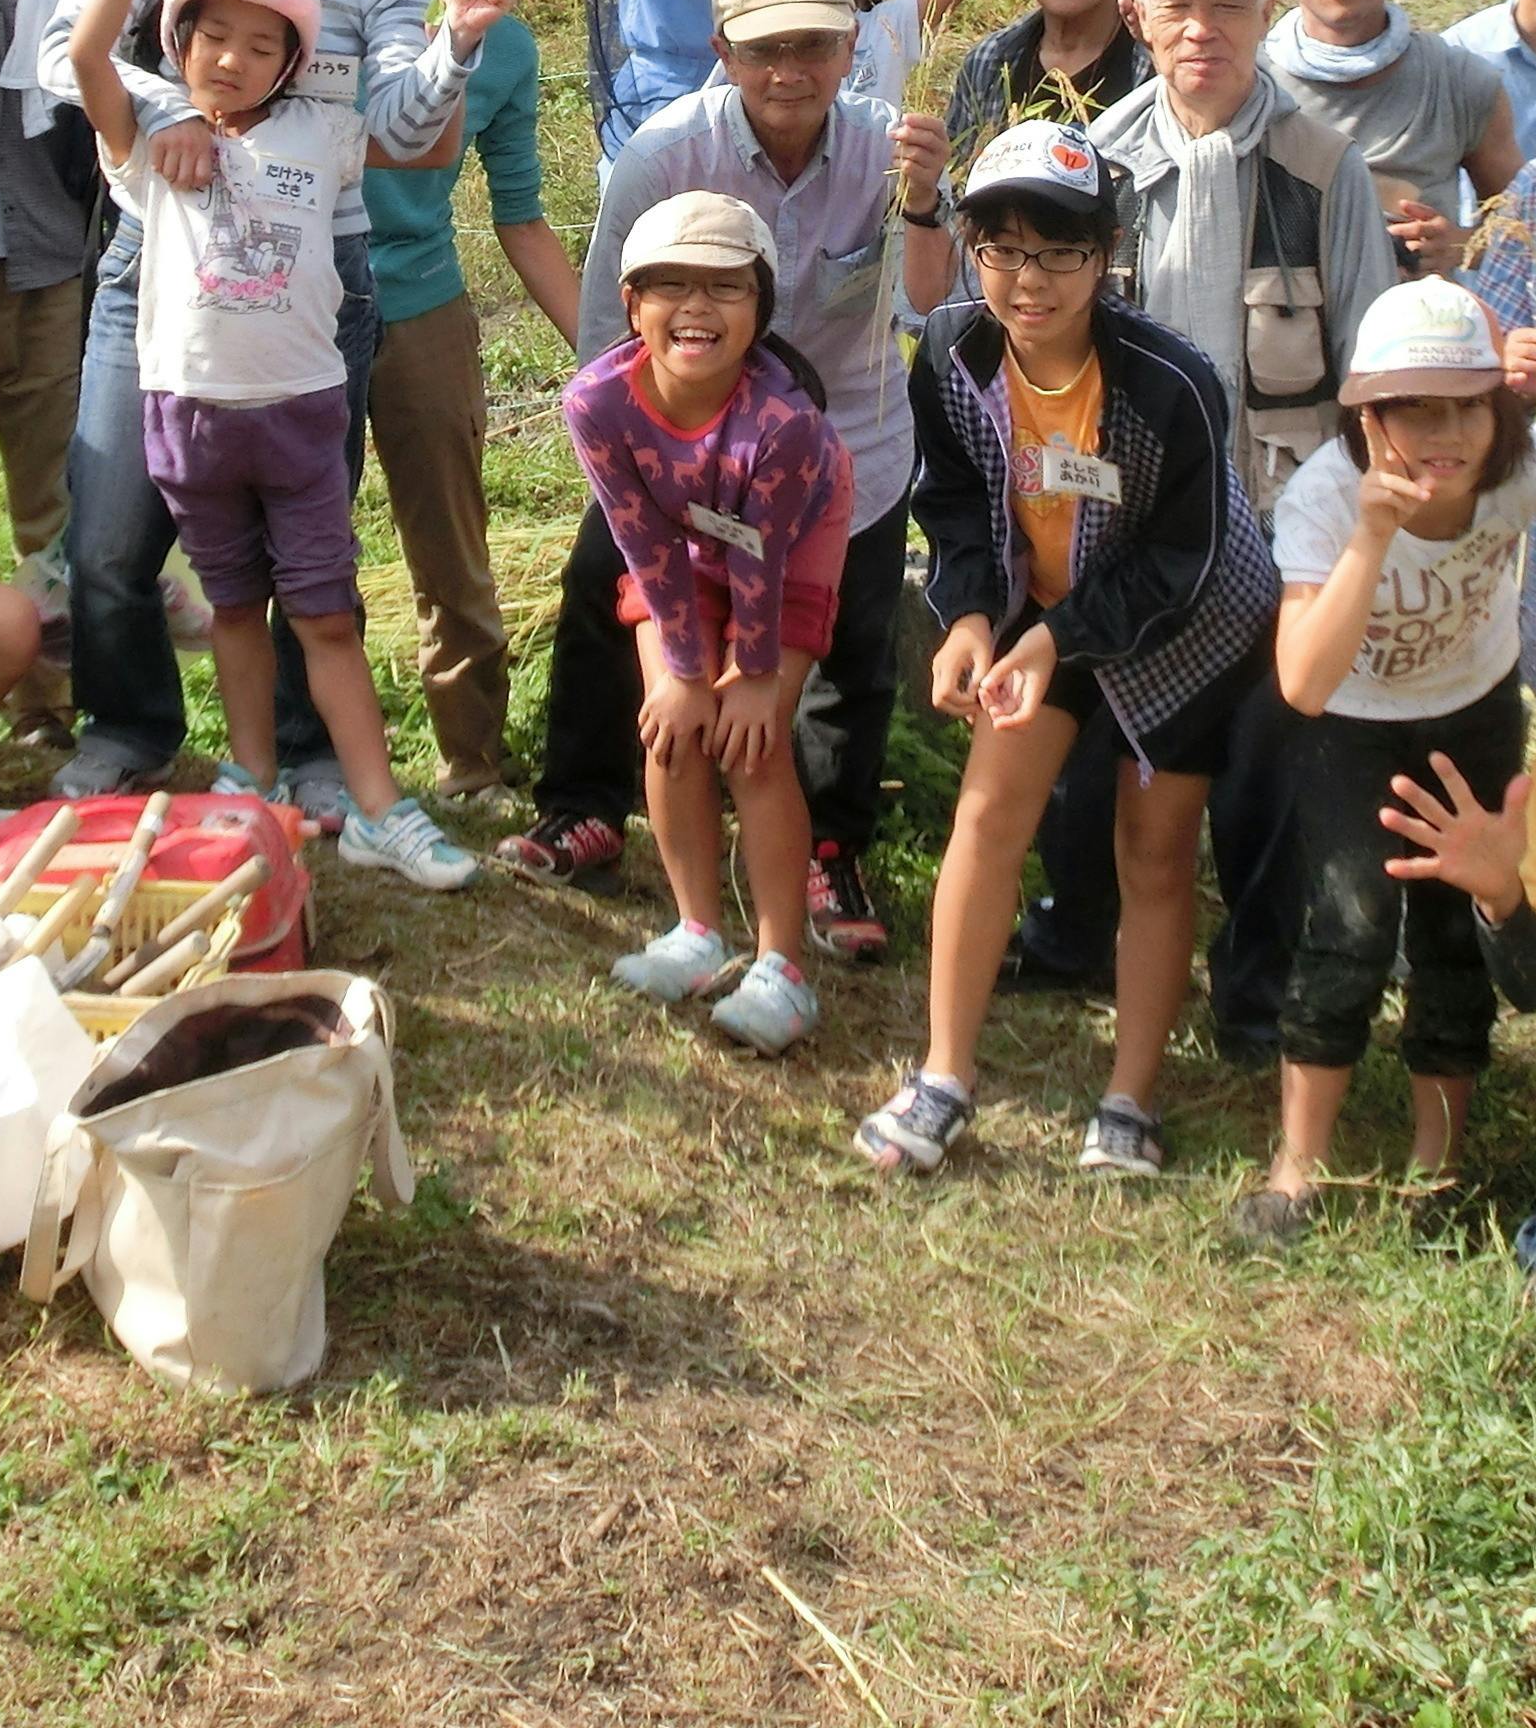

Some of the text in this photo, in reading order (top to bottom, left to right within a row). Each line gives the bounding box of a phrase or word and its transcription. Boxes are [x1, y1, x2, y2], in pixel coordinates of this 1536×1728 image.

[265, 163, 315, 185] たけうち
[276, 182, 301, 198] さき
